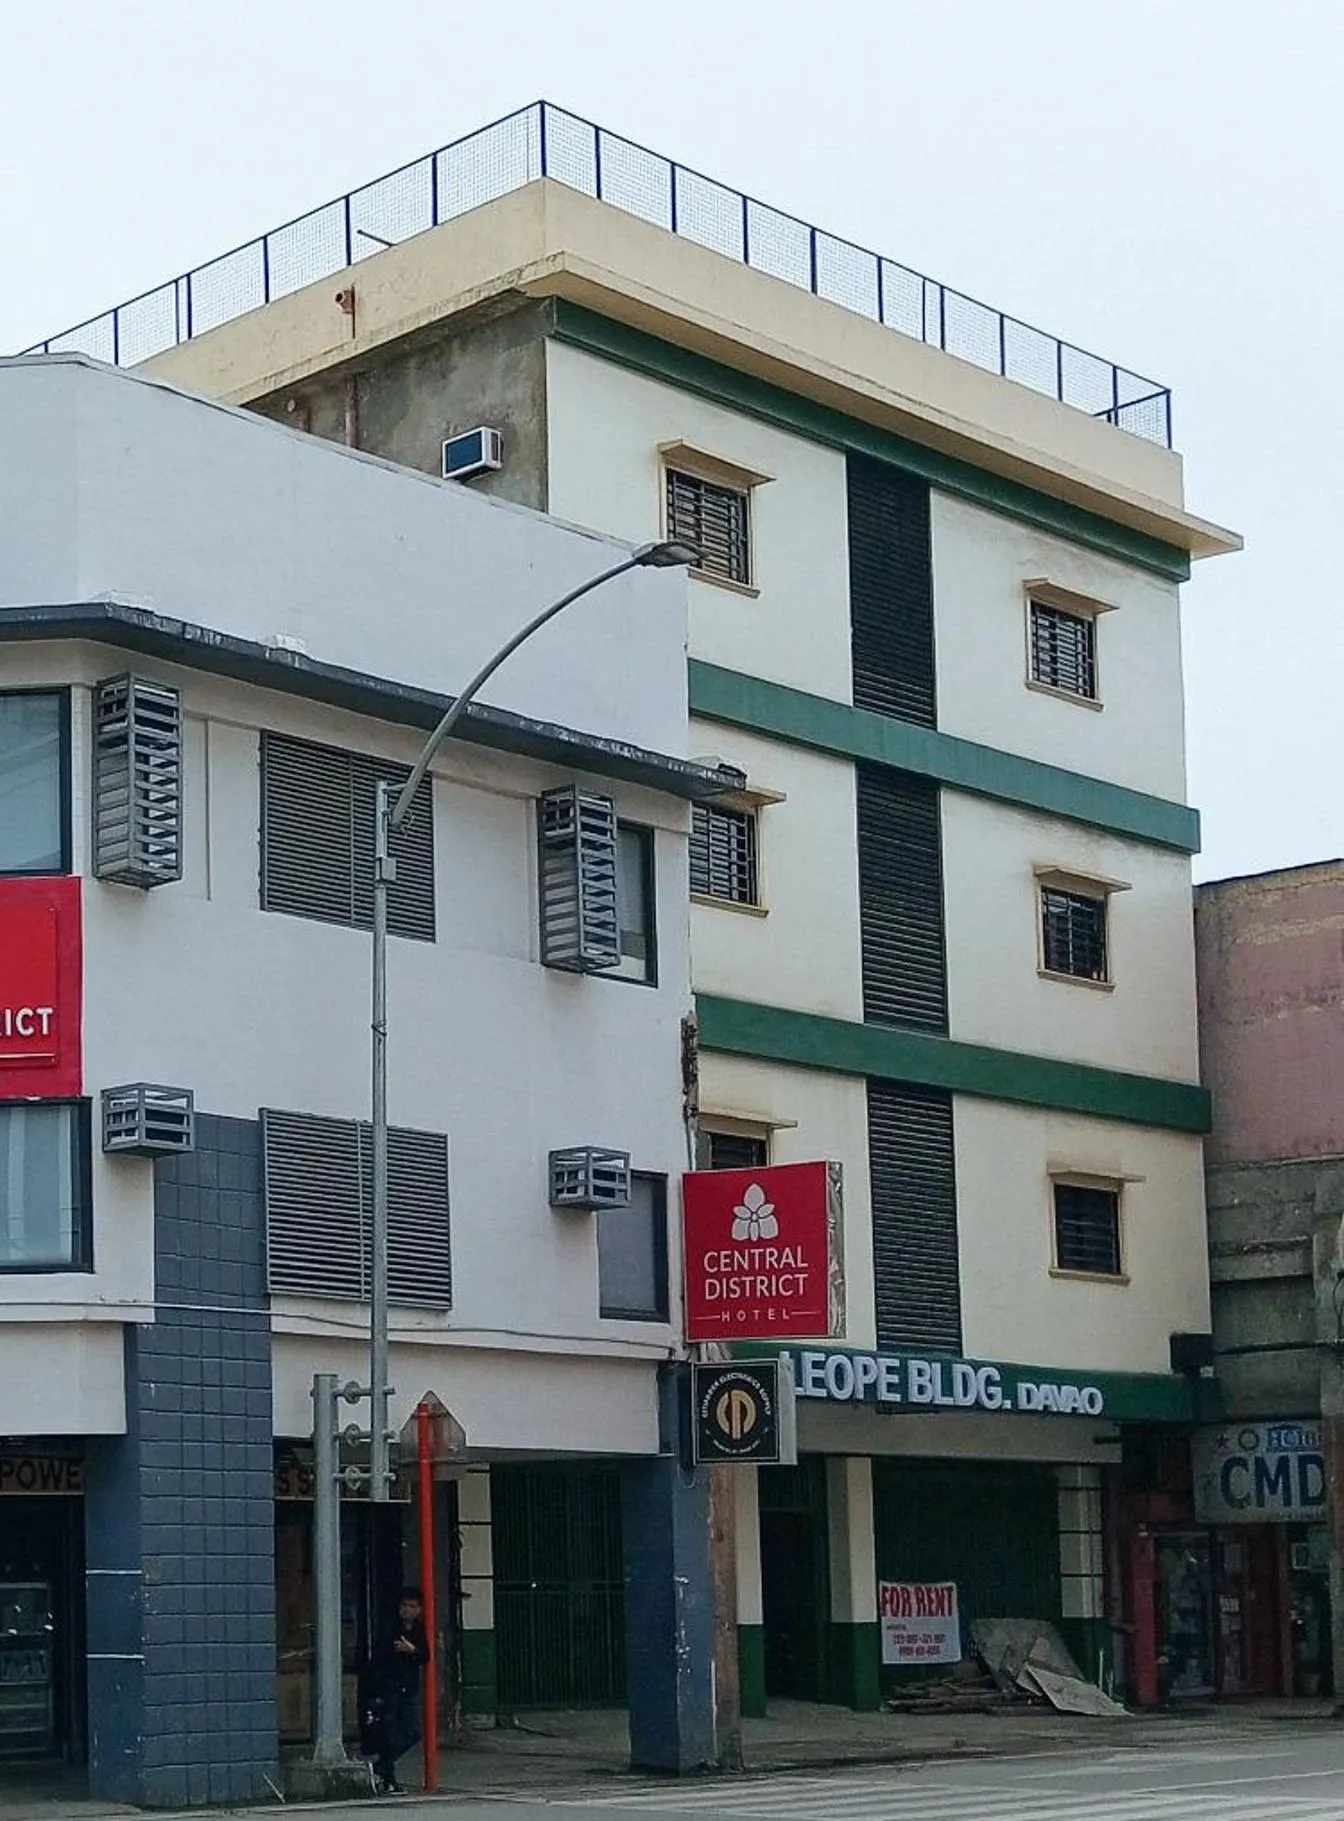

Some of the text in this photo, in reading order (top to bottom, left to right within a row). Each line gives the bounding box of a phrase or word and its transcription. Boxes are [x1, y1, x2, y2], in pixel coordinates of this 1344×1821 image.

[703, 1245, 809, 1273] CENTRAL
[705, 1273, 809, 1301] DISTRICT
[721, 1307, 791, 1322] HOTEL
[907, 1359, 1012, 1410] BLDG.
[1017, 1382, 1104, 1415] DAVAO
[1220, 1453, 1326, 1509] CMD
[881, 1586, 954, 1617] FOR RENT
